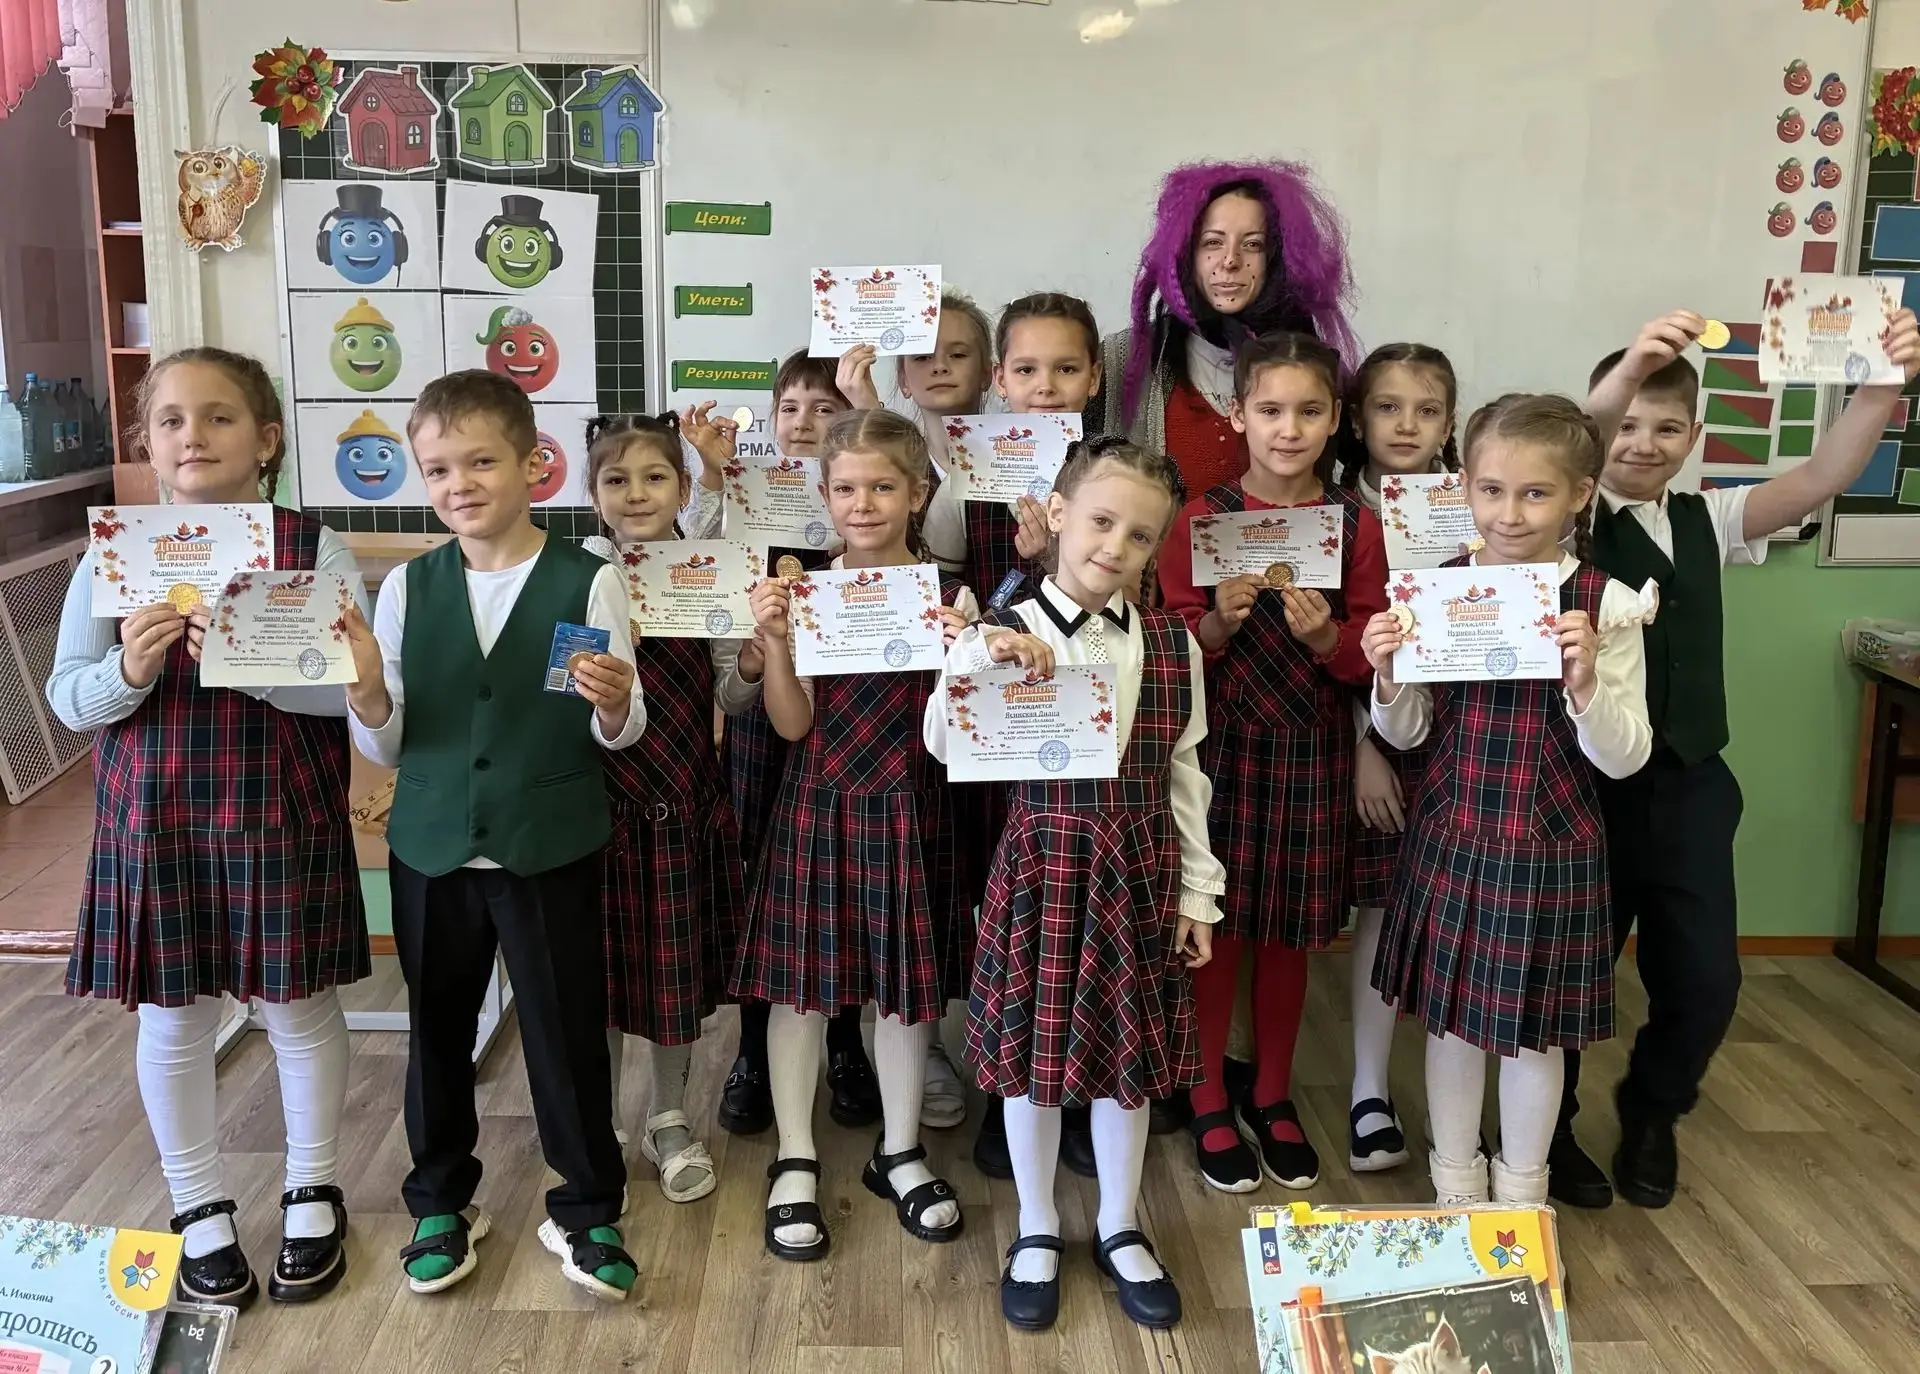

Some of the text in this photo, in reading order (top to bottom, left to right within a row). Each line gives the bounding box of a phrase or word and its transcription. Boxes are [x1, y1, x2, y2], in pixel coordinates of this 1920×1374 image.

[694, 211, 747, 226] Цели:
[687, 293, 744, 308] Уметь:
[685, 367, 769, 381] Результат:
[154, 541, 213, 553] Диплом
[670, 566, 717, 577] Диплом
[840, 584, 888, 595] Диплом
[1447, 603, 1500, 614] Диплом
[1003, 685, 1057, 697] Диплом
[1006, 703, 1053, 711] НАГРАЖДАЕТСЯ
[1461, 1236, 1481, 1276] ШКОЛА
[10, 1288, 54, 1304] Илюхина
[1510, 1290, 1529, 1305] bg
[105, 1293, 140, 1321] РОССИИ
[188, 1324, 205, 1341] bg
